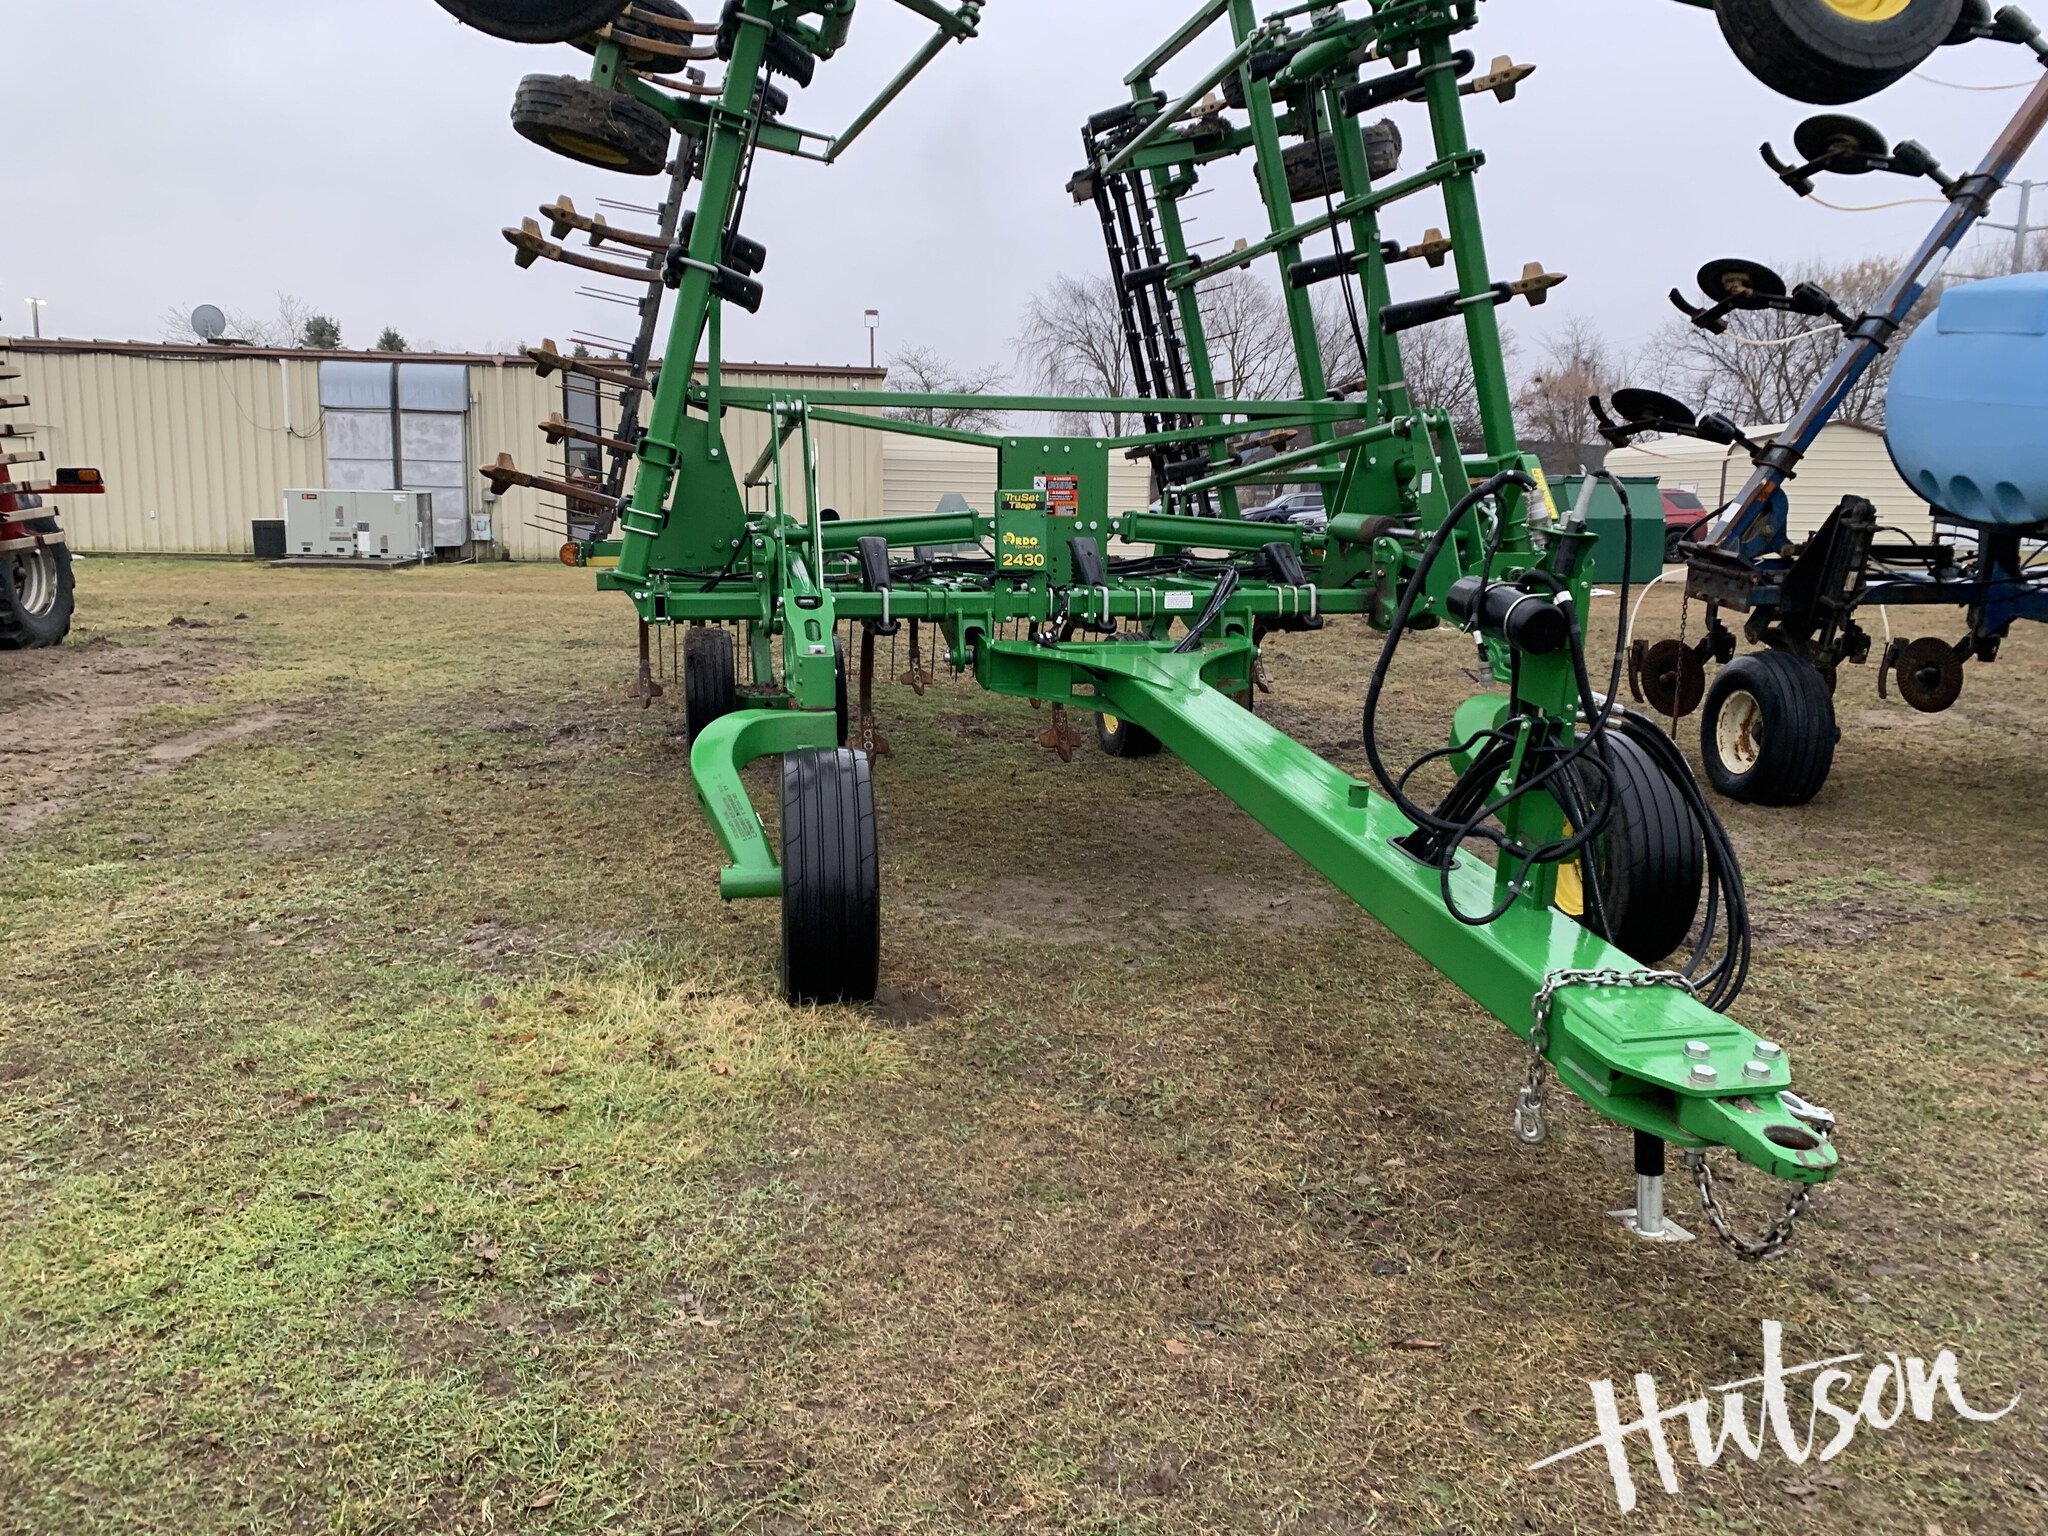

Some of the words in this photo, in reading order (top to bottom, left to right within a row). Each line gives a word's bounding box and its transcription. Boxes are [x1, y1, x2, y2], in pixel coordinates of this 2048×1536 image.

[1005, 493, 1039, 502] TruSet
[1009, 501, 1036, 510] Tillage
[1002, 553, 1045, 566] 2430
